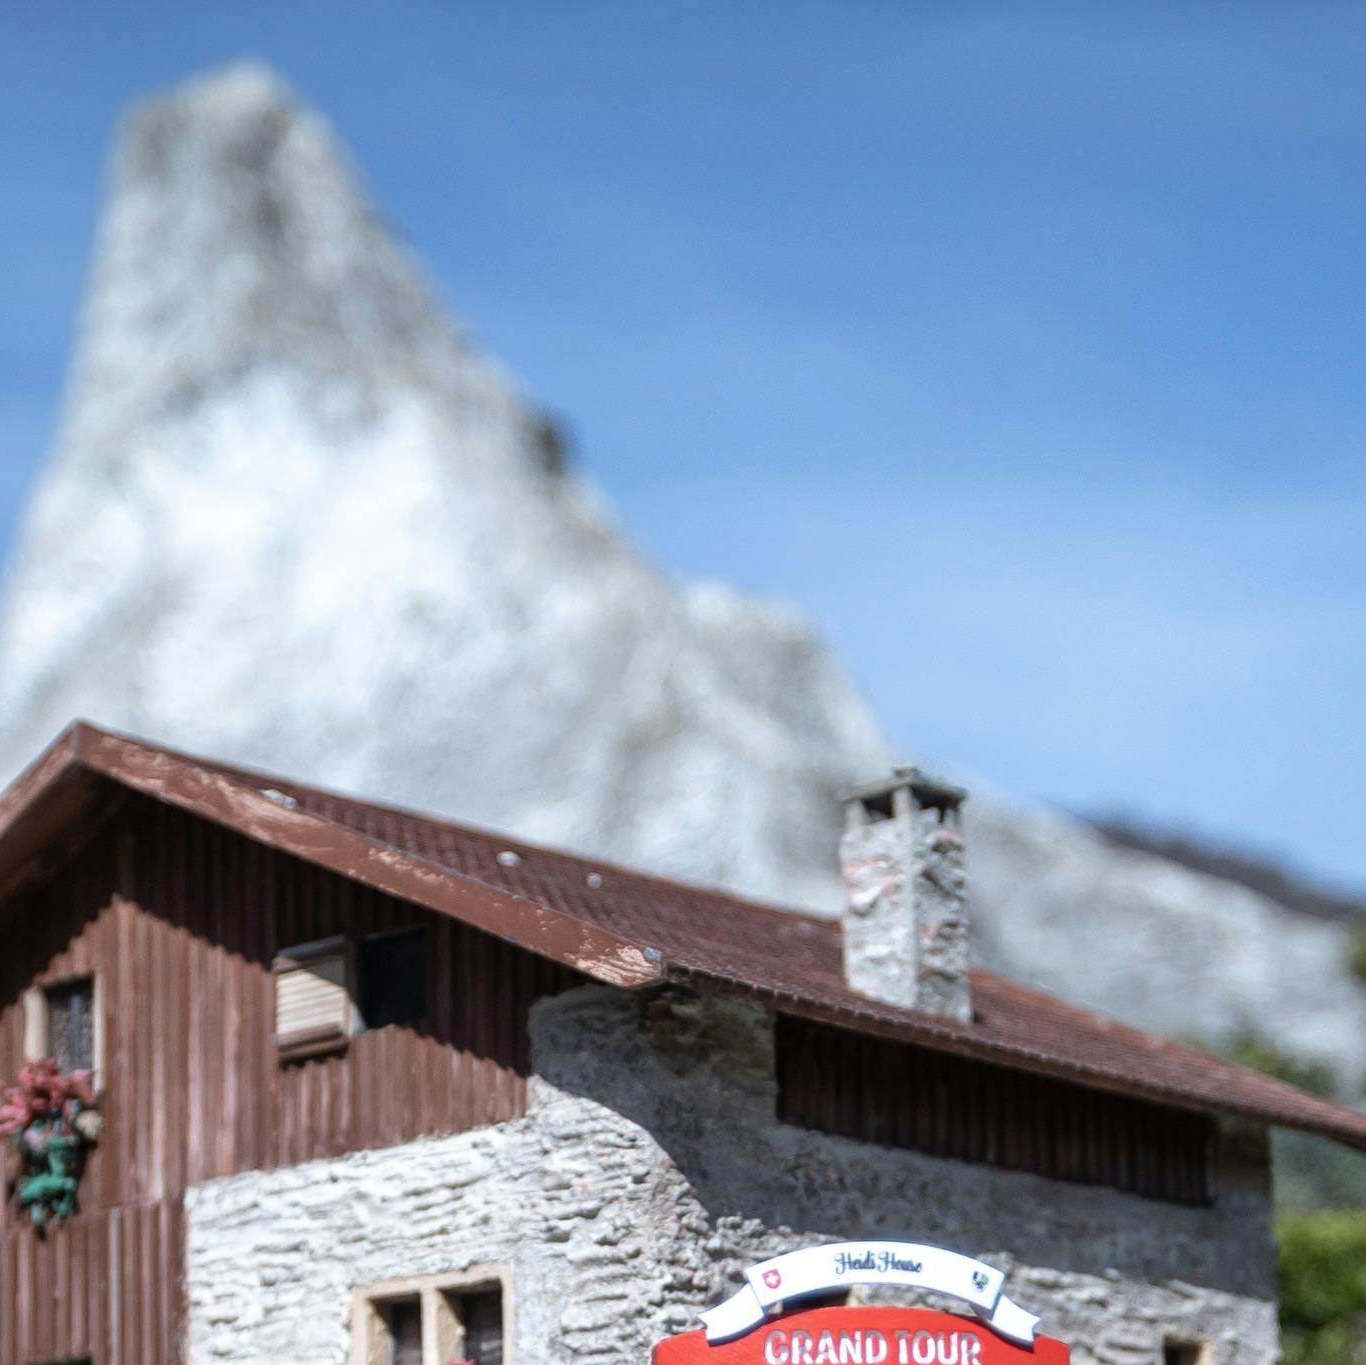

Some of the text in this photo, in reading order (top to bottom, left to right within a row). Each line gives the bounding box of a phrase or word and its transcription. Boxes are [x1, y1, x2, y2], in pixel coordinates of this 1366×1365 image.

[834, 1250, 924, 1275] Heidi House
[765, 1330, 887, 1365] GRAND
